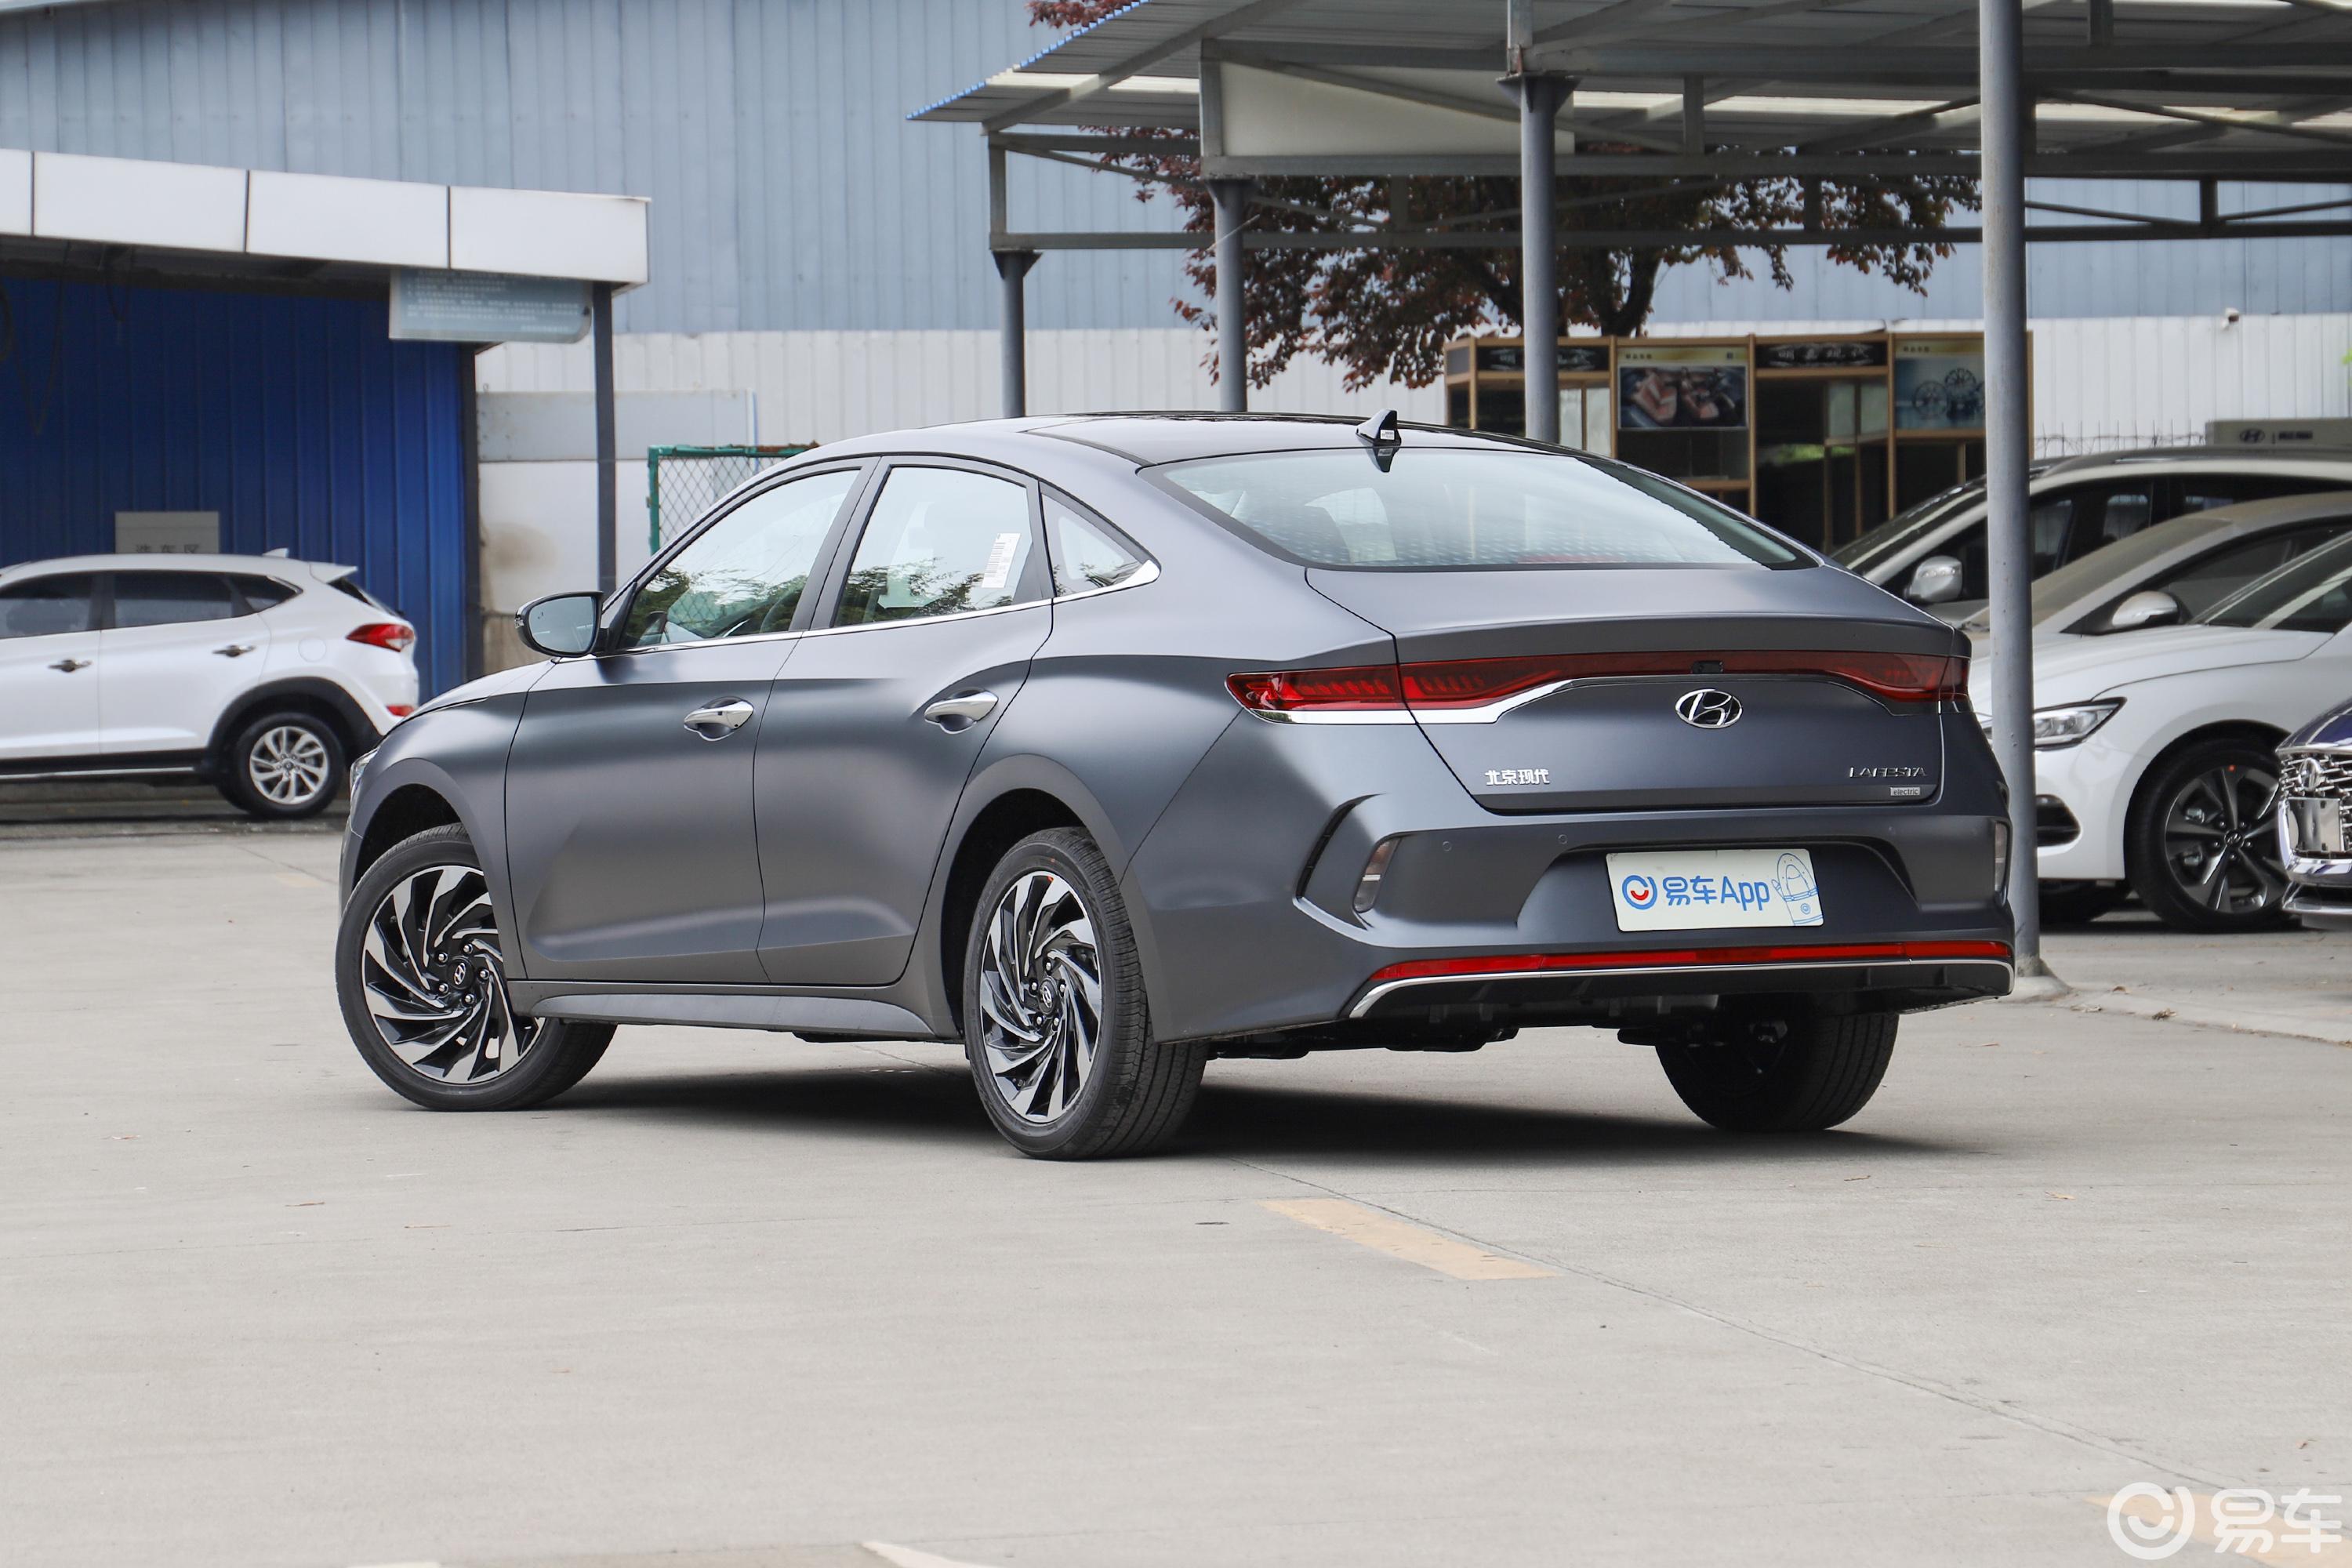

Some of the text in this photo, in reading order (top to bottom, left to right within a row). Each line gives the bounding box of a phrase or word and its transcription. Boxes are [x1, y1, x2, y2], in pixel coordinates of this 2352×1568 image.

[1484, 768, 1551, 786] 北京现代
[1849, 768, 1927, 777] LAFESTA
[1662, 876, 1770, 911] 易车App
